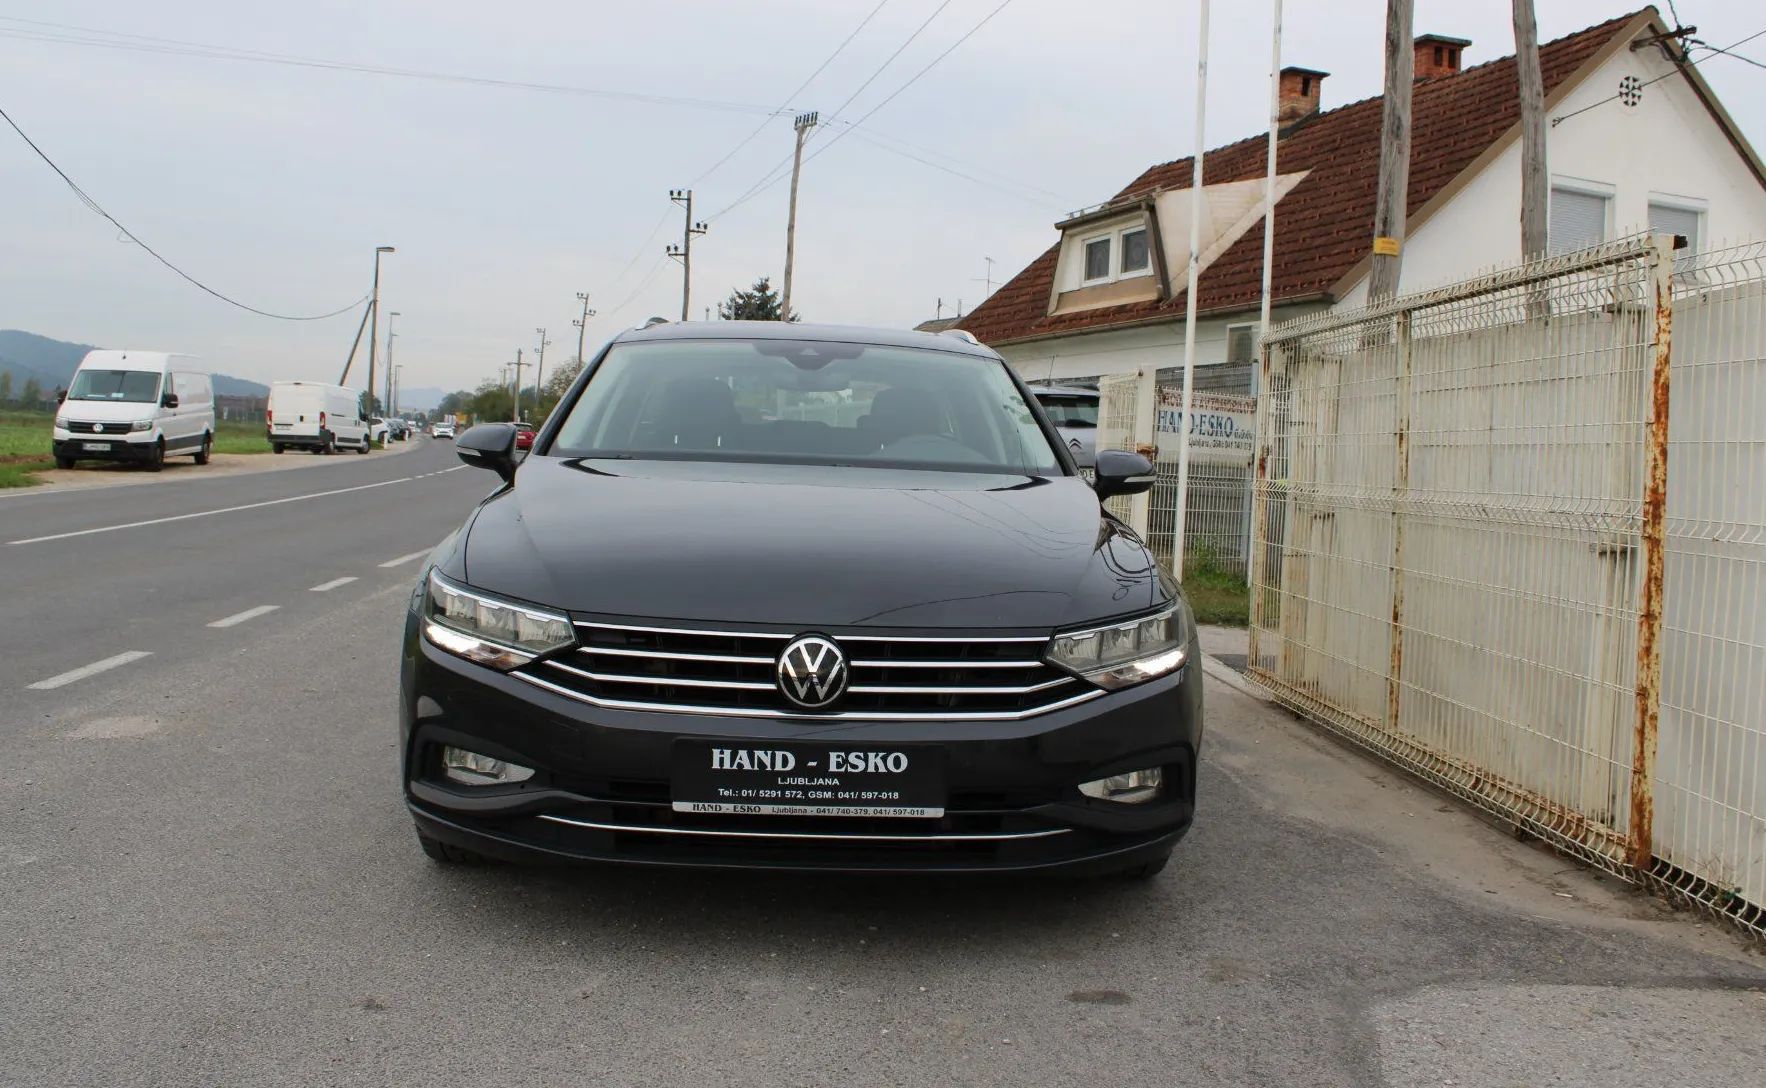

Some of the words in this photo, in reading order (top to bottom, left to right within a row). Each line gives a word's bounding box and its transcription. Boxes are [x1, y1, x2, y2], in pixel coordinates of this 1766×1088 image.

[711, 748, 796, 771] HAND
[828, 751, 909, 773] ESKO
[777, 777, 840, 786] LJUBLJANA
[718, 788, 739, 797] Tel.:
[741, 789, 756, 797] 01/
[759, 789, 782, 798] 5291
[785, 790, 805, 799] 572,
[808, 790, 835, 799] GSM:
[837, 791, 859, 799] 041/
[861, 791, 899, 799] 597-018
[692, 803, 722, 812] HAND
[733, 804, 762, 813] ESKO
[771, 806, 808, 815] Ljubljana
[816, 807, 834, 815] 041/
[836, 807, 871, 816] 740-379,
[873, 808, 891, 816] 041/
[893, 808, 925, 816] 597-018
